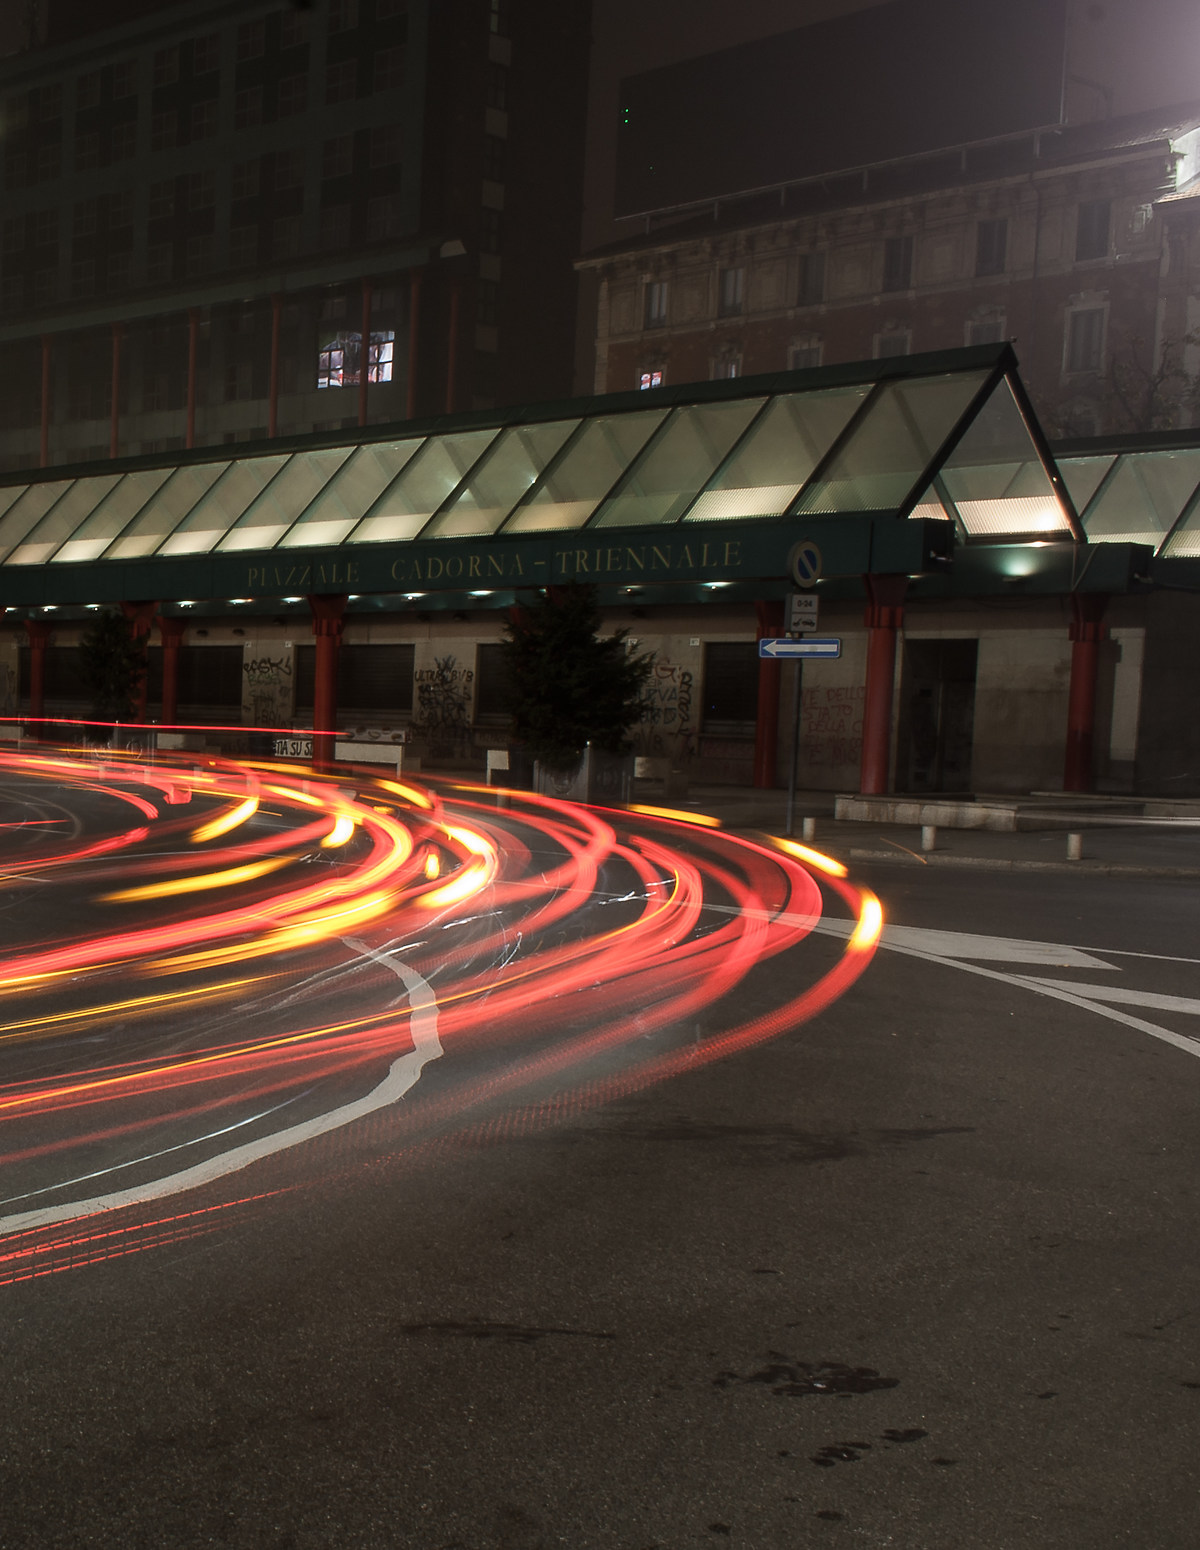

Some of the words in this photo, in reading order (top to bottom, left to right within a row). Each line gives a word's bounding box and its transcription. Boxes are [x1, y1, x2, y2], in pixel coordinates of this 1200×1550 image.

[247, 562, 360, 588] PIAZZALE
[391, 552, 525, 583] CADORNA
[556, 541, 743, 575] TRIENNALE
